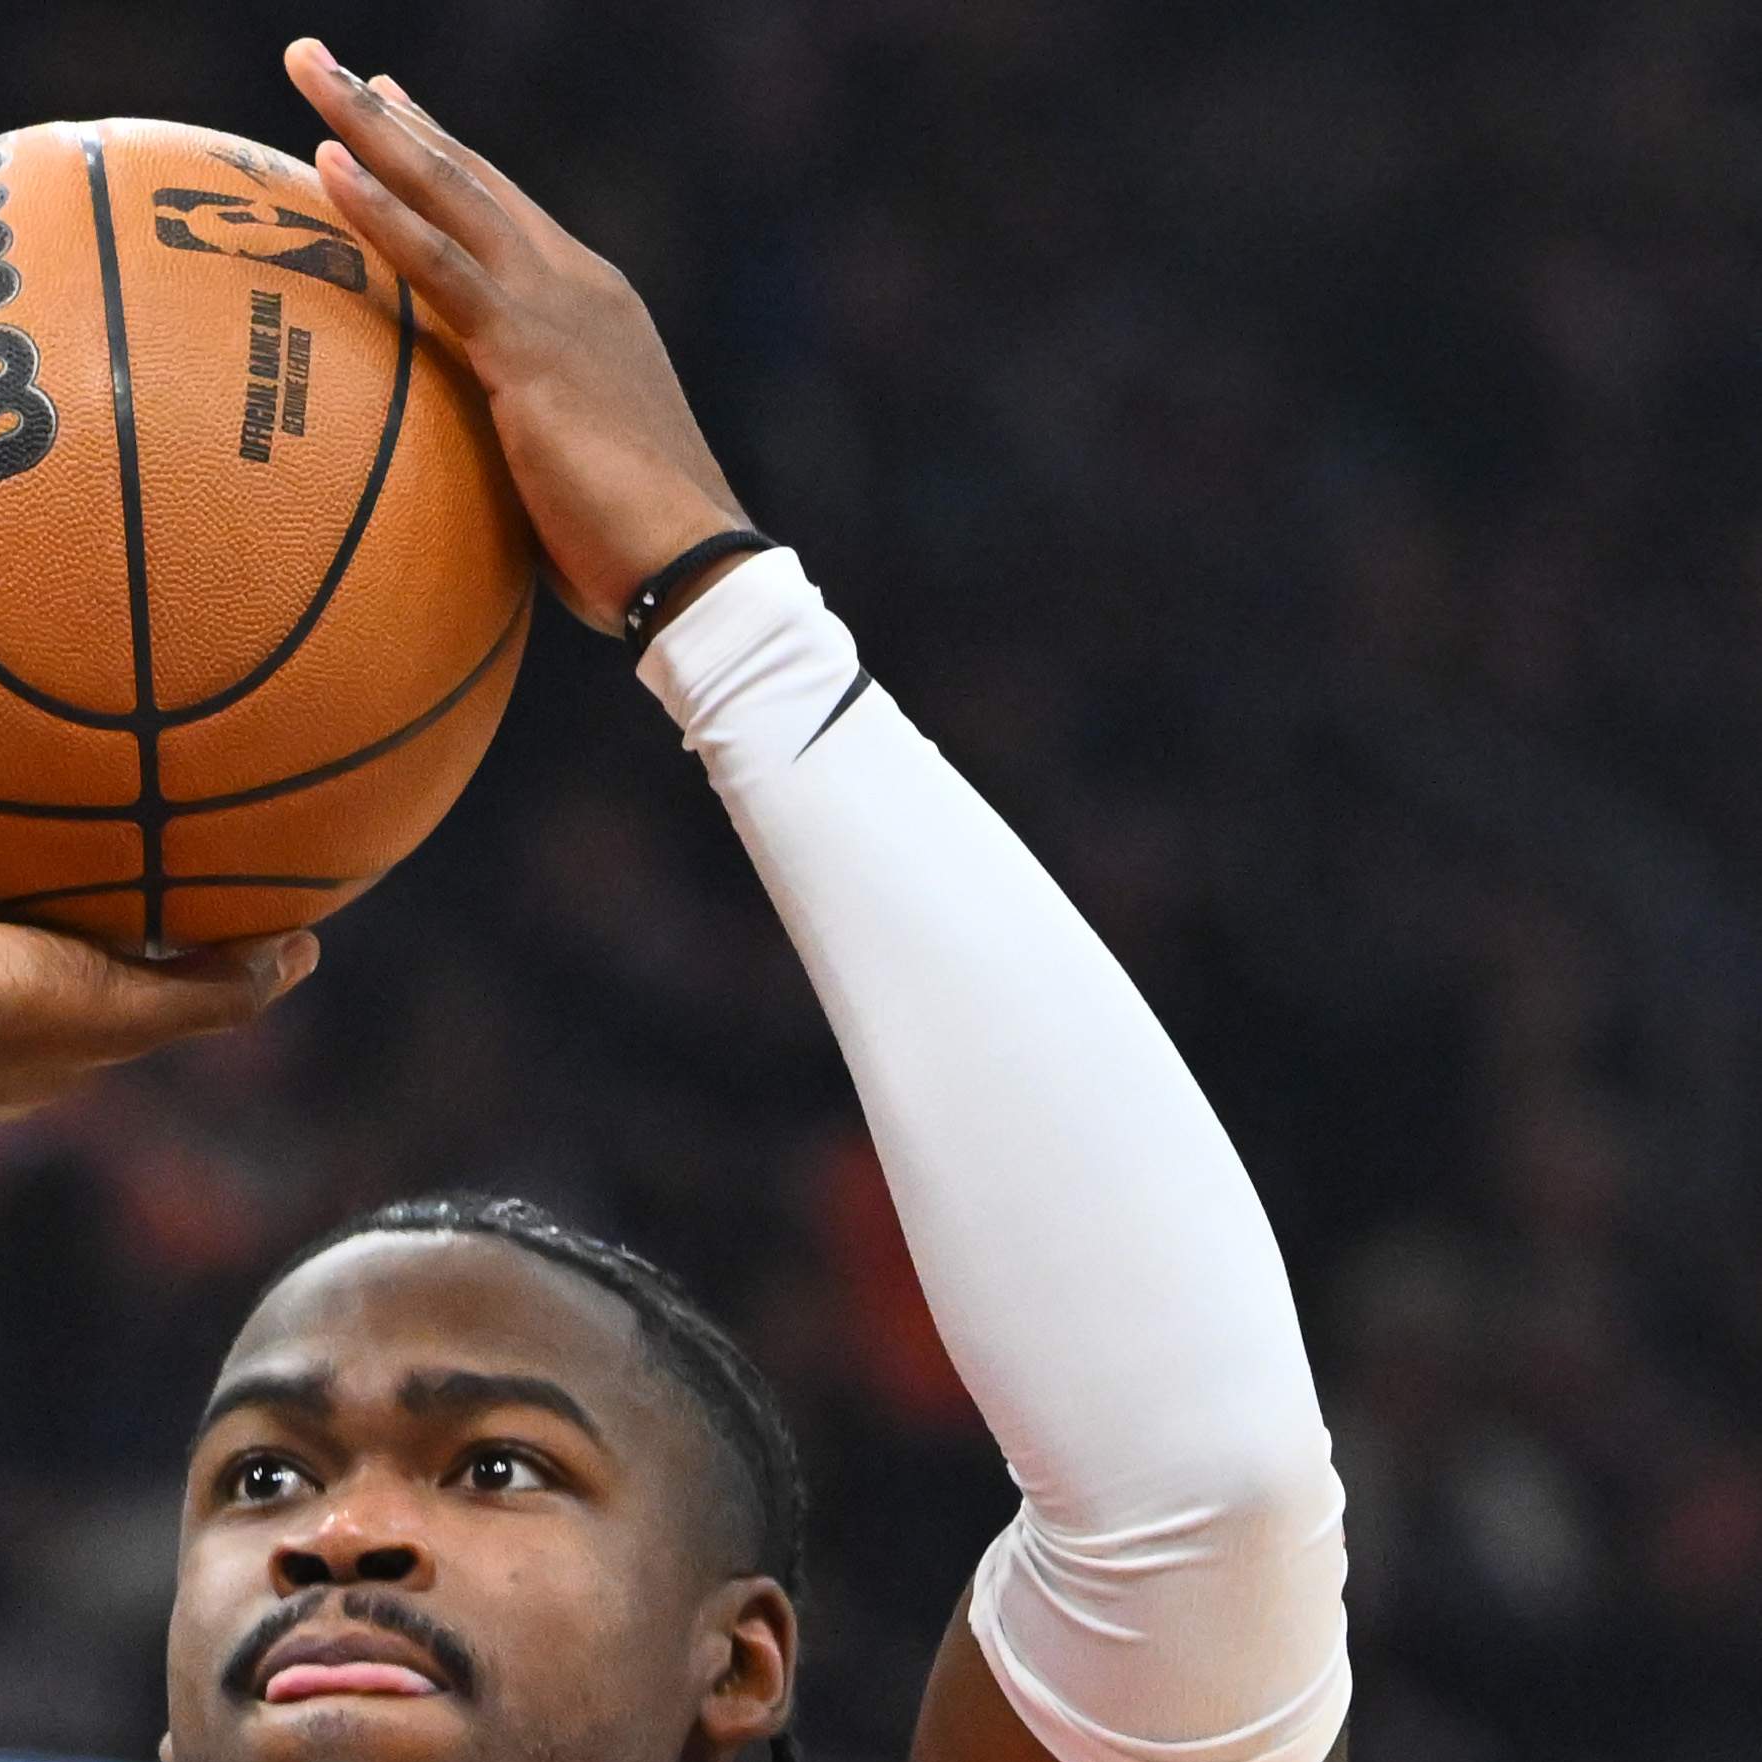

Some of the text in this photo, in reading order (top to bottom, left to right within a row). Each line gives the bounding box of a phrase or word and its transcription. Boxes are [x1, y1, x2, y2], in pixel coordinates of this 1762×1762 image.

[240, 290, 281, 462] OFFICIAL GAME BALL
